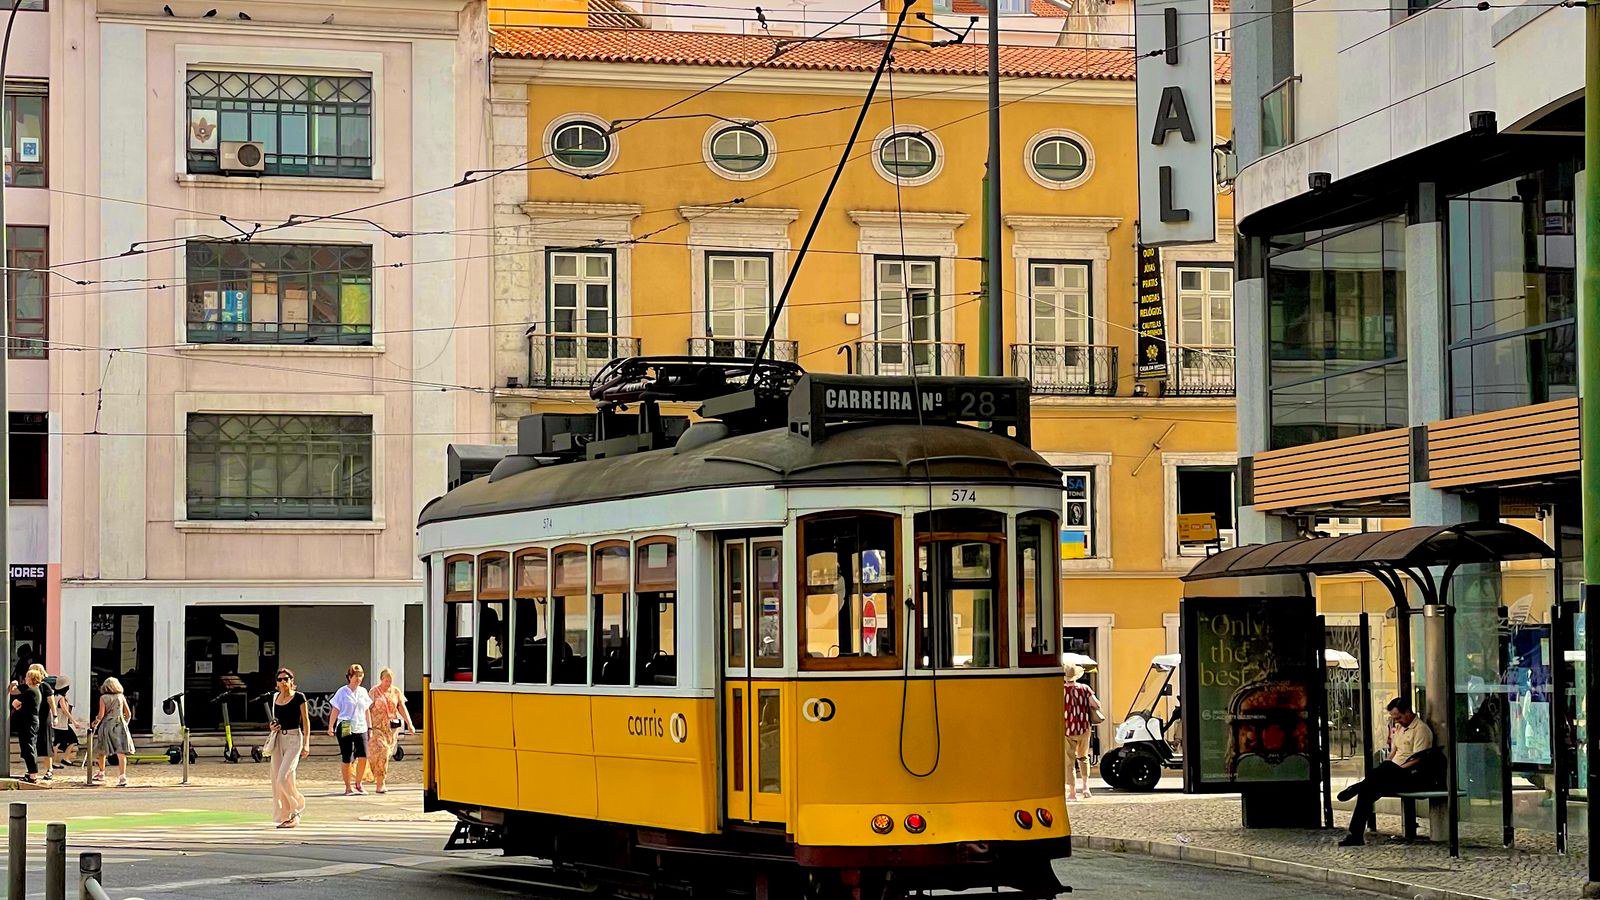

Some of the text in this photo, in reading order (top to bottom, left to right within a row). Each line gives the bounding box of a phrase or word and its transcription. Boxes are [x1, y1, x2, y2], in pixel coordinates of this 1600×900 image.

[825, 388, 912, 411] CARREIRA
[960, 391, 996, 416] 28
[952, 489, 976, 502] 574
[543, 517, 553, 529] 574
[627, 708, 664, 738] carris
